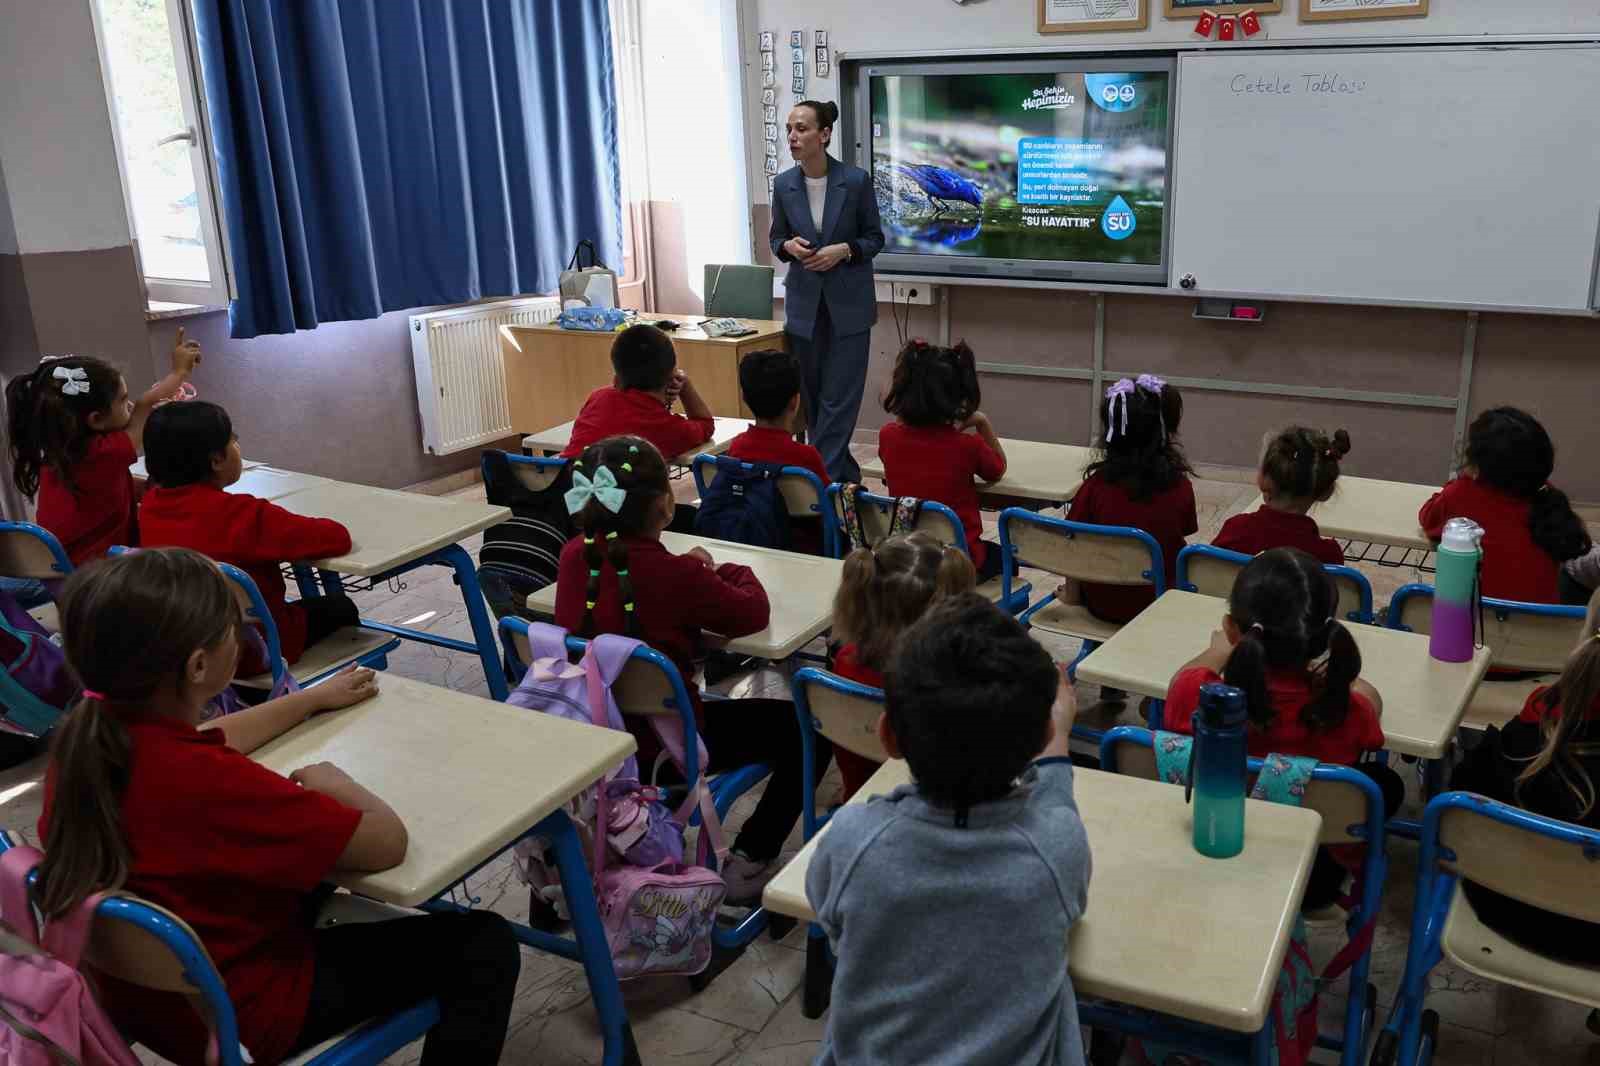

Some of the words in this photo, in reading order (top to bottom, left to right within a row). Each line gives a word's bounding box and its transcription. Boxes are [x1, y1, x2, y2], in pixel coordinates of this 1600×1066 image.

[1021, 91, 1075, 110] Hepimizin
[1047, 184, 1079, 192] dolmayan
[1080, 184, 1099, 193] doğal
[1109, 216, 1130, 231] SU
